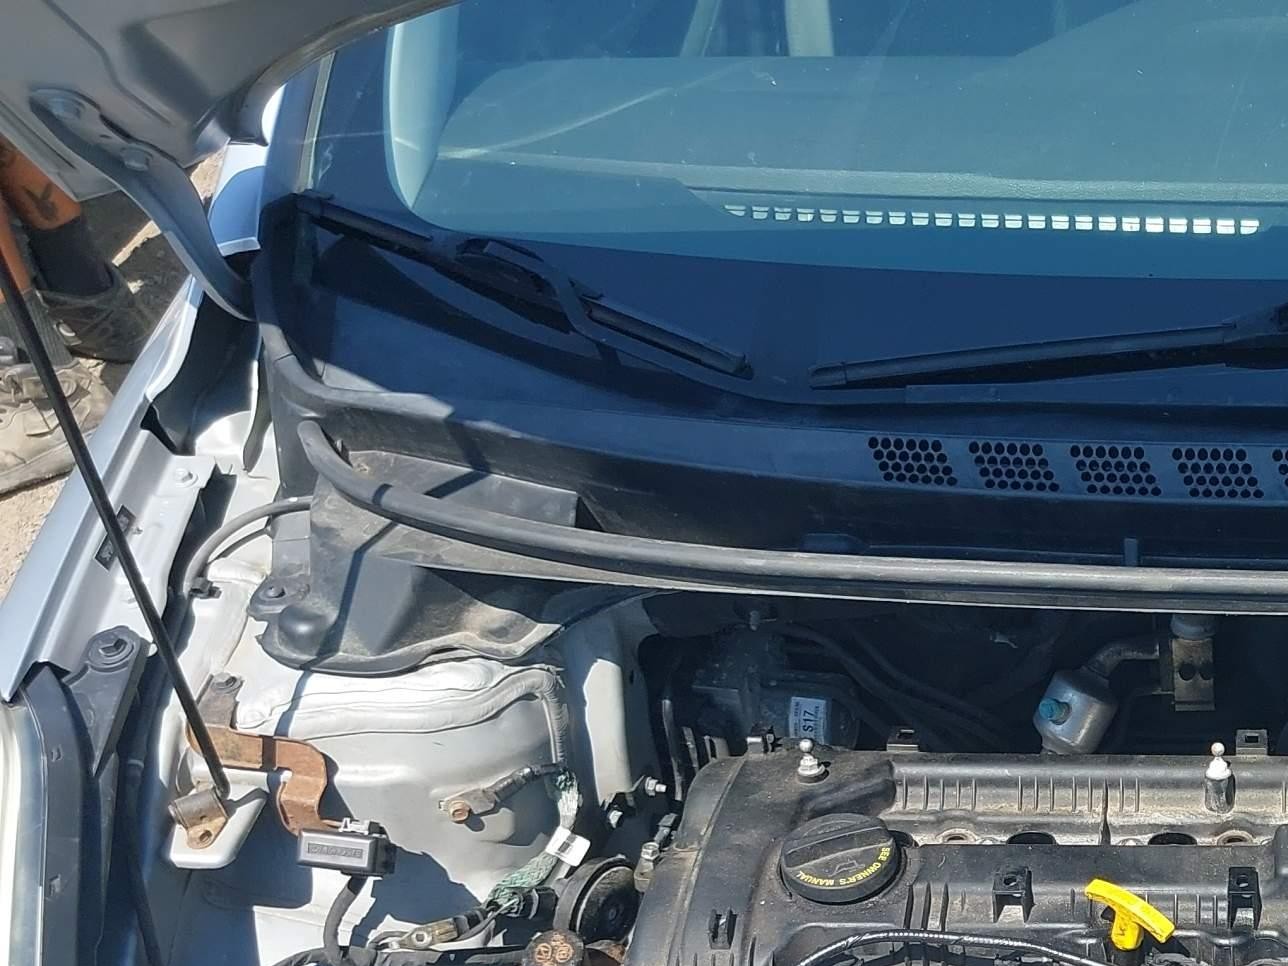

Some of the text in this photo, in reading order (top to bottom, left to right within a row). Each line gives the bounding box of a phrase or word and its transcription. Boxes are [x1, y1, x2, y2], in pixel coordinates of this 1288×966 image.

[795, 847, 891, 886] SEE OWNER'S MANUAL
